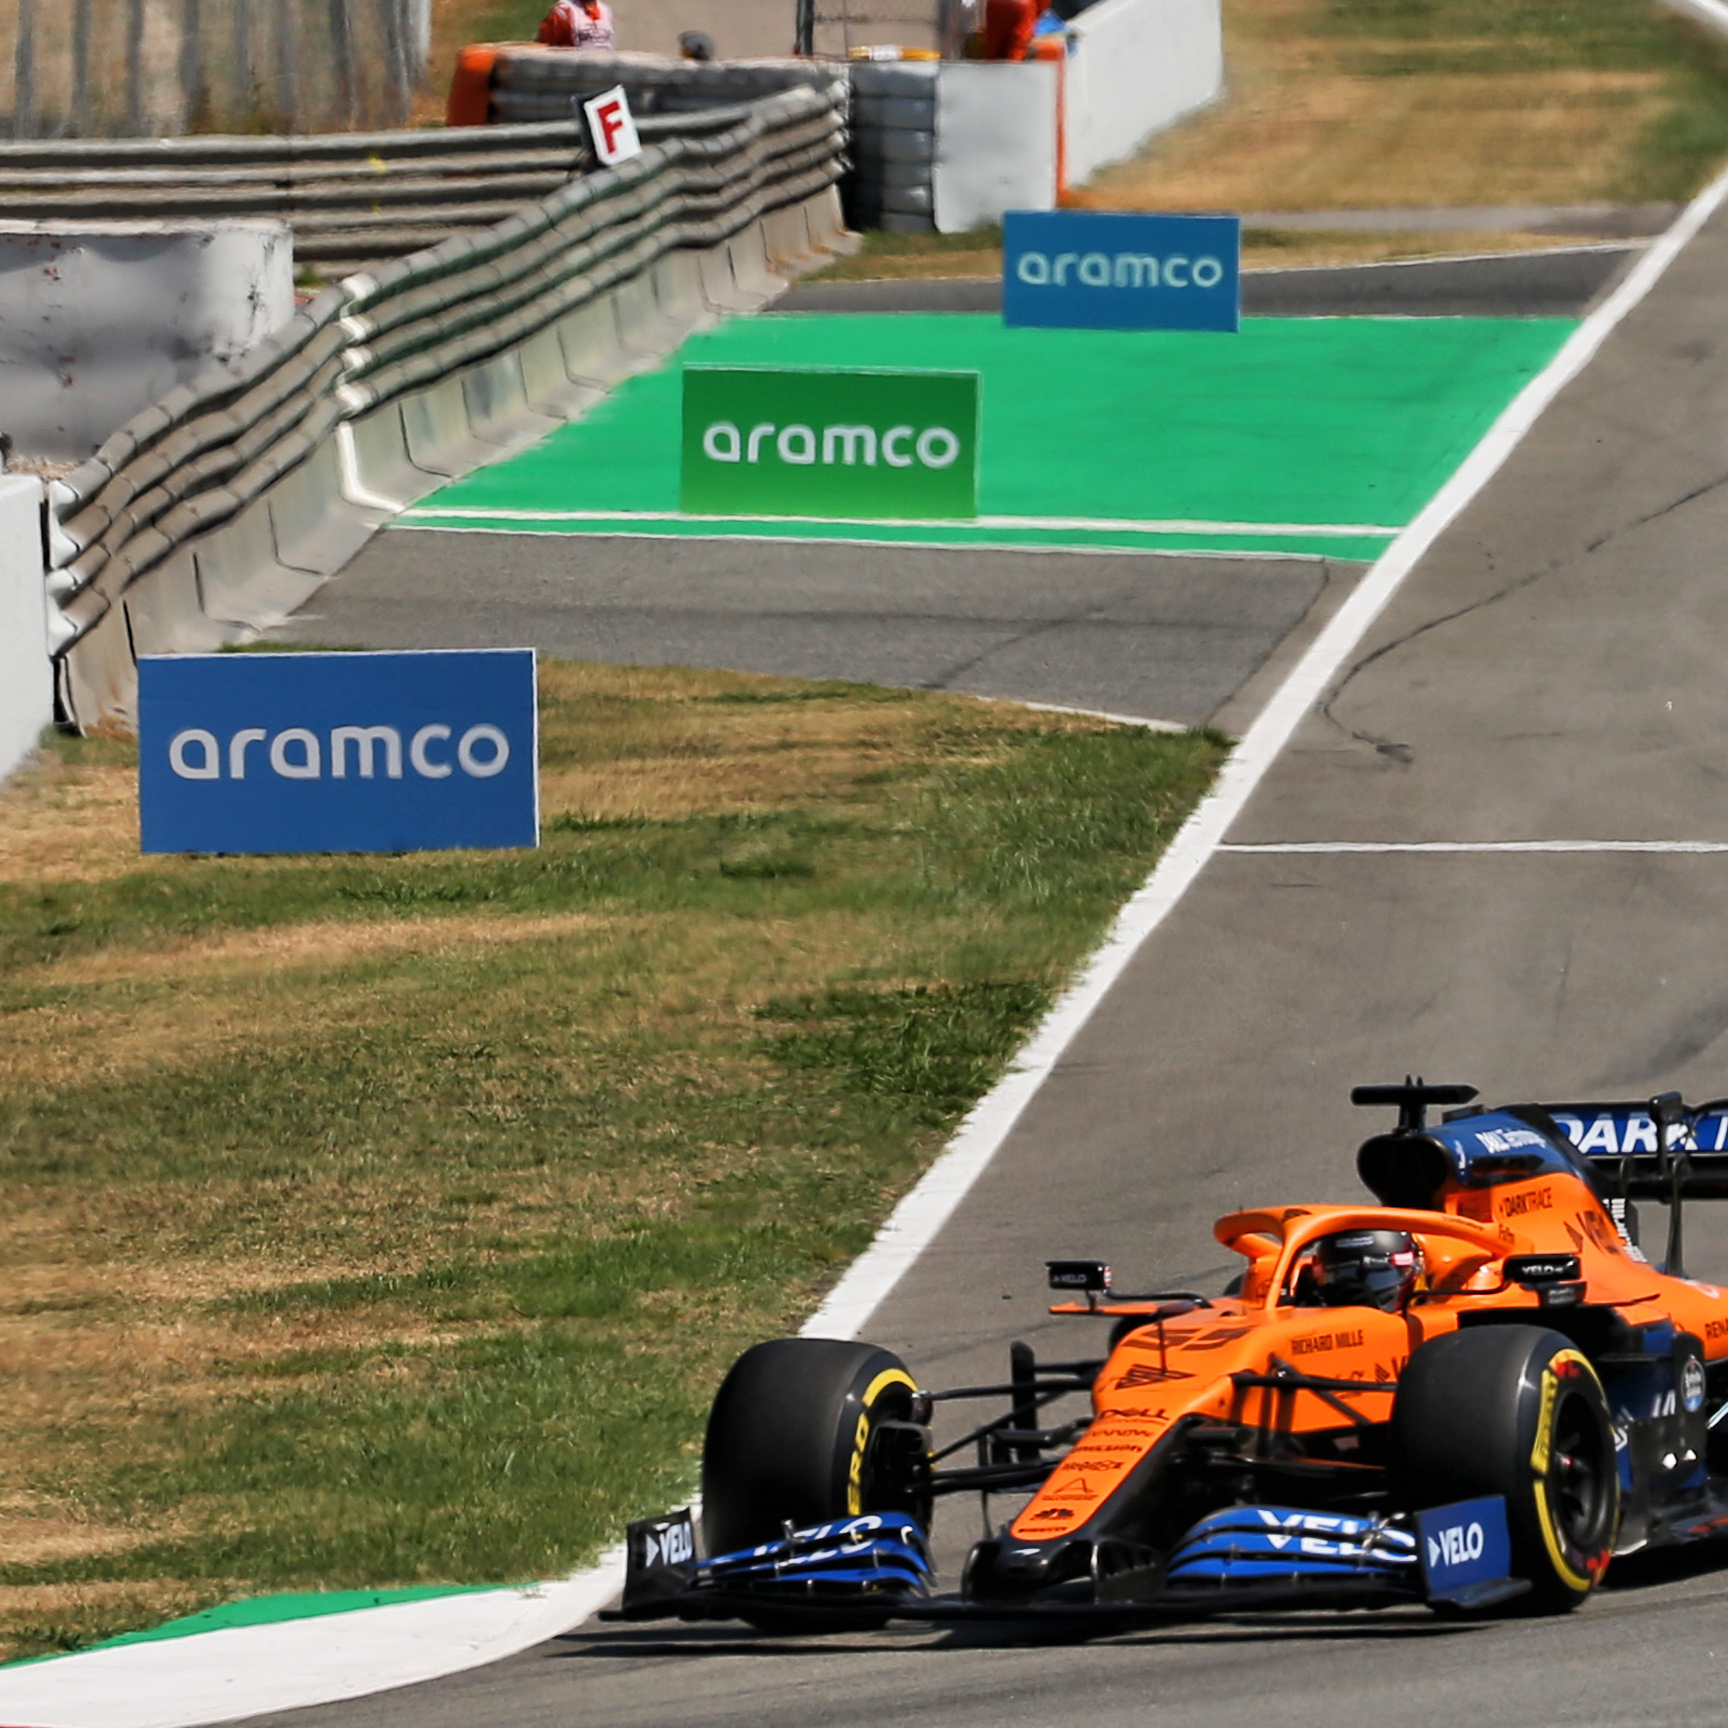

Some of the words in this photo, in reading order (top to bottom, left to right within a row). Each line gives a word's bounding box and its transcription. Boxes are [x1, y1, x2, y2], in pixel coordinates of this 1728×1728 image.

[595, 99, 624, 155] F
[1016, 250, 1224, 290] aramco
[703, 421, 961, 470] aramco
[168, 723, 511, 781] aramco
[1522, 1265, 1555, 1276] VELO
[1291, 1334, 1334, 1355] RICHARD
[1335, 1329, 1365, 1349] MILLE
[660, 1521, 693, 1566] VELO
[1256, 1509, 1418, 1562] VELO
[1439, 1521, 1484, 1567] VELO
